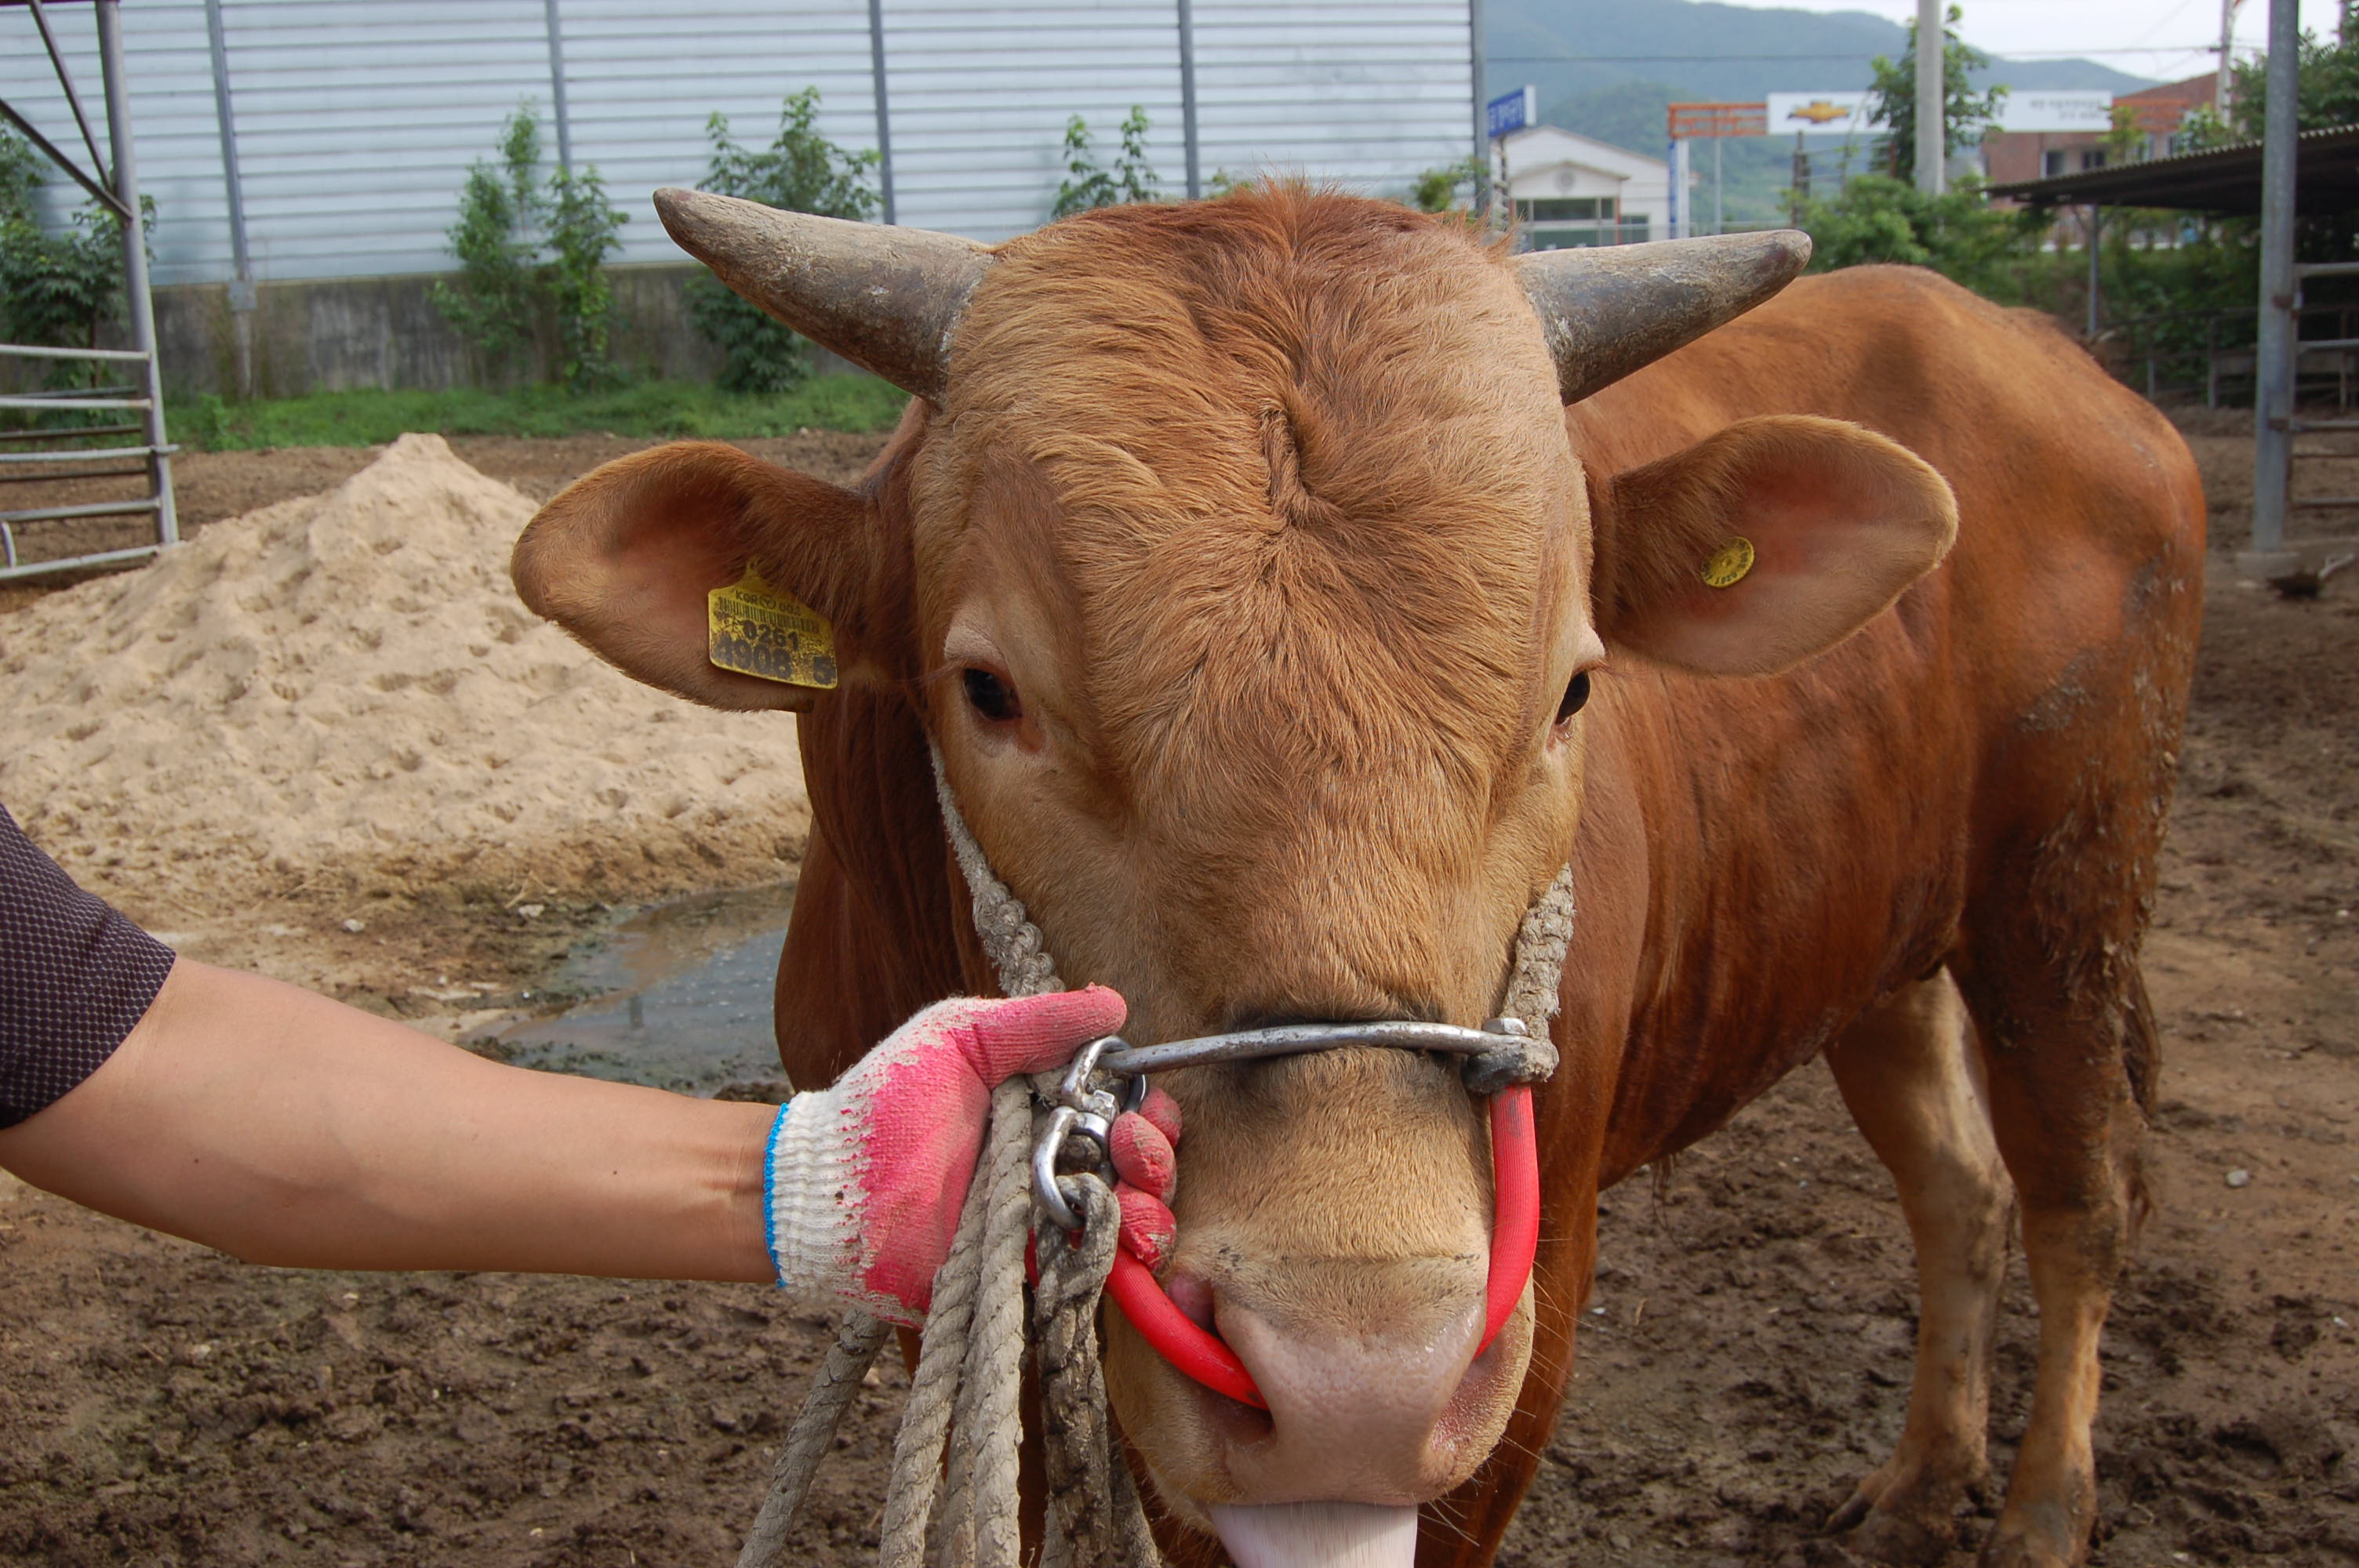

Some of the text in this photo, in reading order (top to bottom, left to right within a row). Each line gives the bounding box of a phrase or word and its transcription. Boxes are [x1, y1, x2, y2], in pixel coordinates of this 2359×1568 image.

[736, 590, 801, 616] KOR 002
[744, 619, 798, 652] 0261
